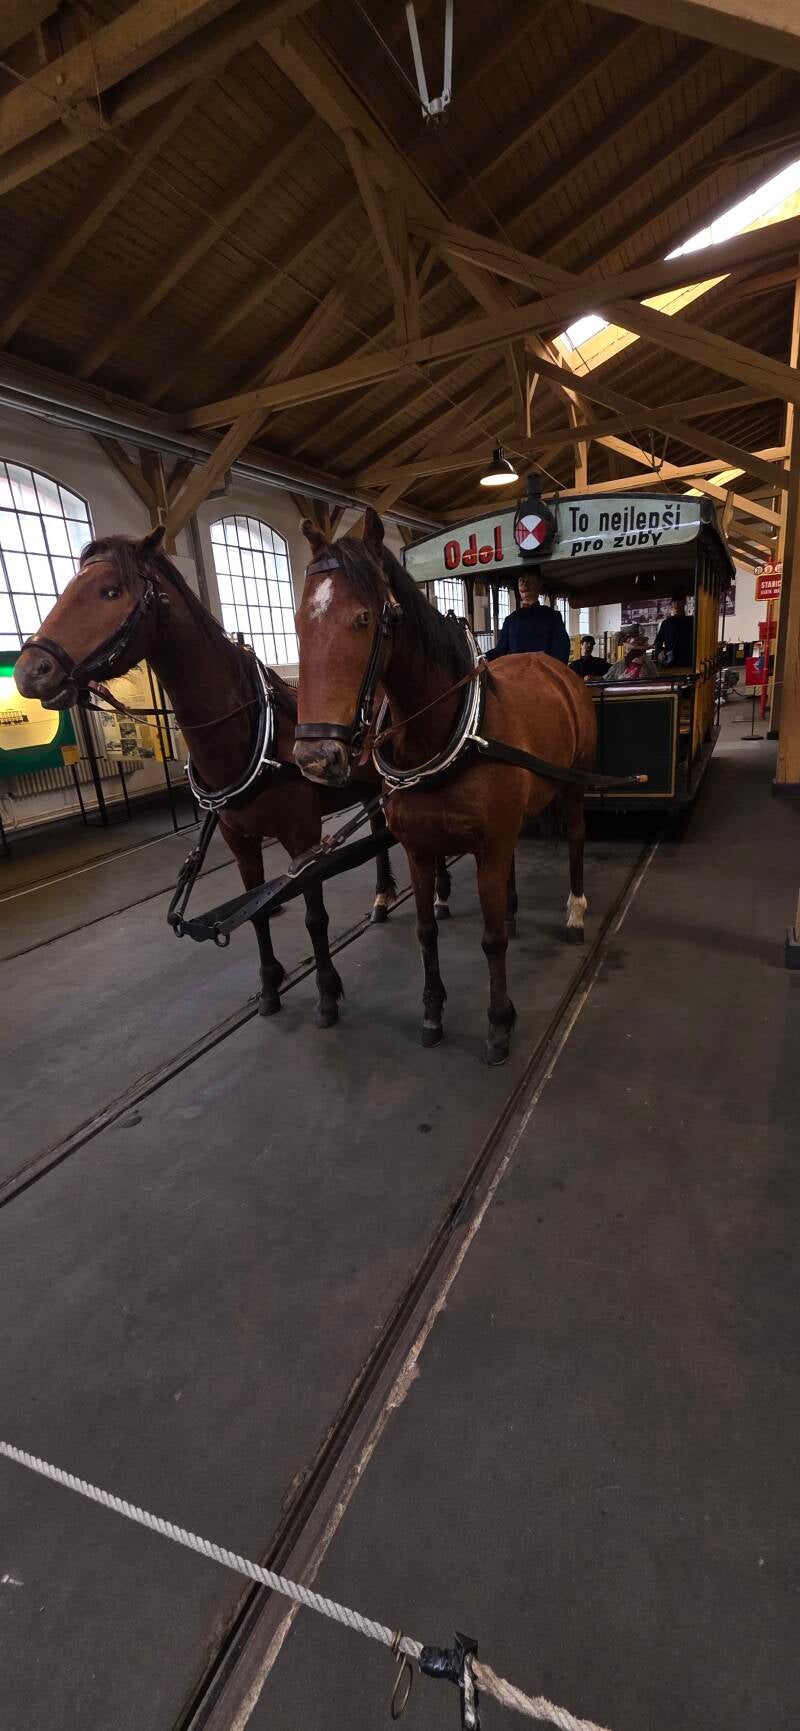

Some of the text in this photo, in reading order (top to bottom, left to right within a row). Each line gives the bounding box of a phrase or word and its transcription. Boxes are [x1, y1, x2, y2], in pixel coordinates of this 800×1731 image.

[569, 507, 589, 533] To
[443, 525, 505, 570] Odol
[570, 539, 604, 556] pro
